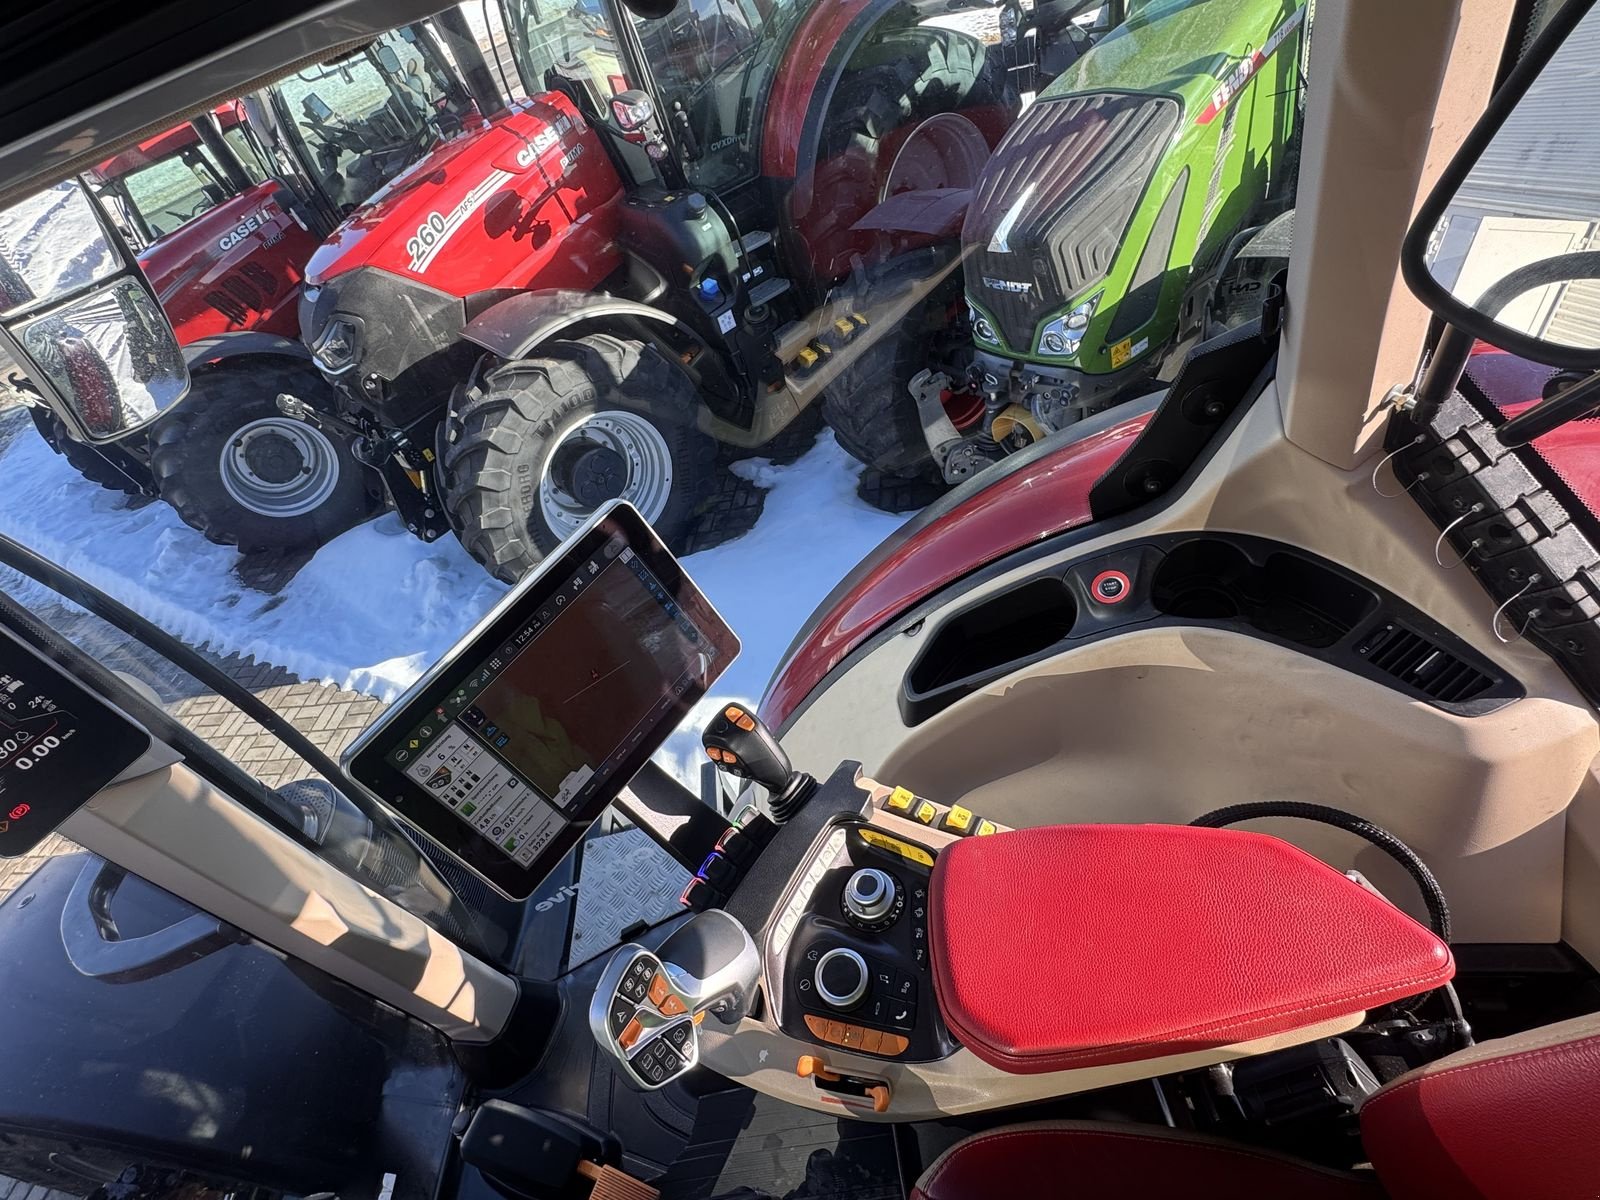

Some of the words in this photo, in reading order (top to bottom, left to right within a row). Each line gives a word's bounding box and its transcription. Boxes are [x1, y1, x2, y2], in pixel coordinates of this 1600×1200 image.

[1211, 48, 1256, 111] FENDT
[516, 125, 560, 167] CASE
[560, 143, 584, 169] PUMA
[460, 197, 474, 215] AFS
[219, 218, 258, 251] CASE
[408, 213, 445, 262] 260
[982, 276, 1032, 293] FENDT
[515, 625, 534, 646] 12:54
[15, 736, 60, 770] 0.00
[437, 752, 445, 761] 6
[479, 817, 491, 830] 4,8
[533, 832, 550, 852] 323,4
